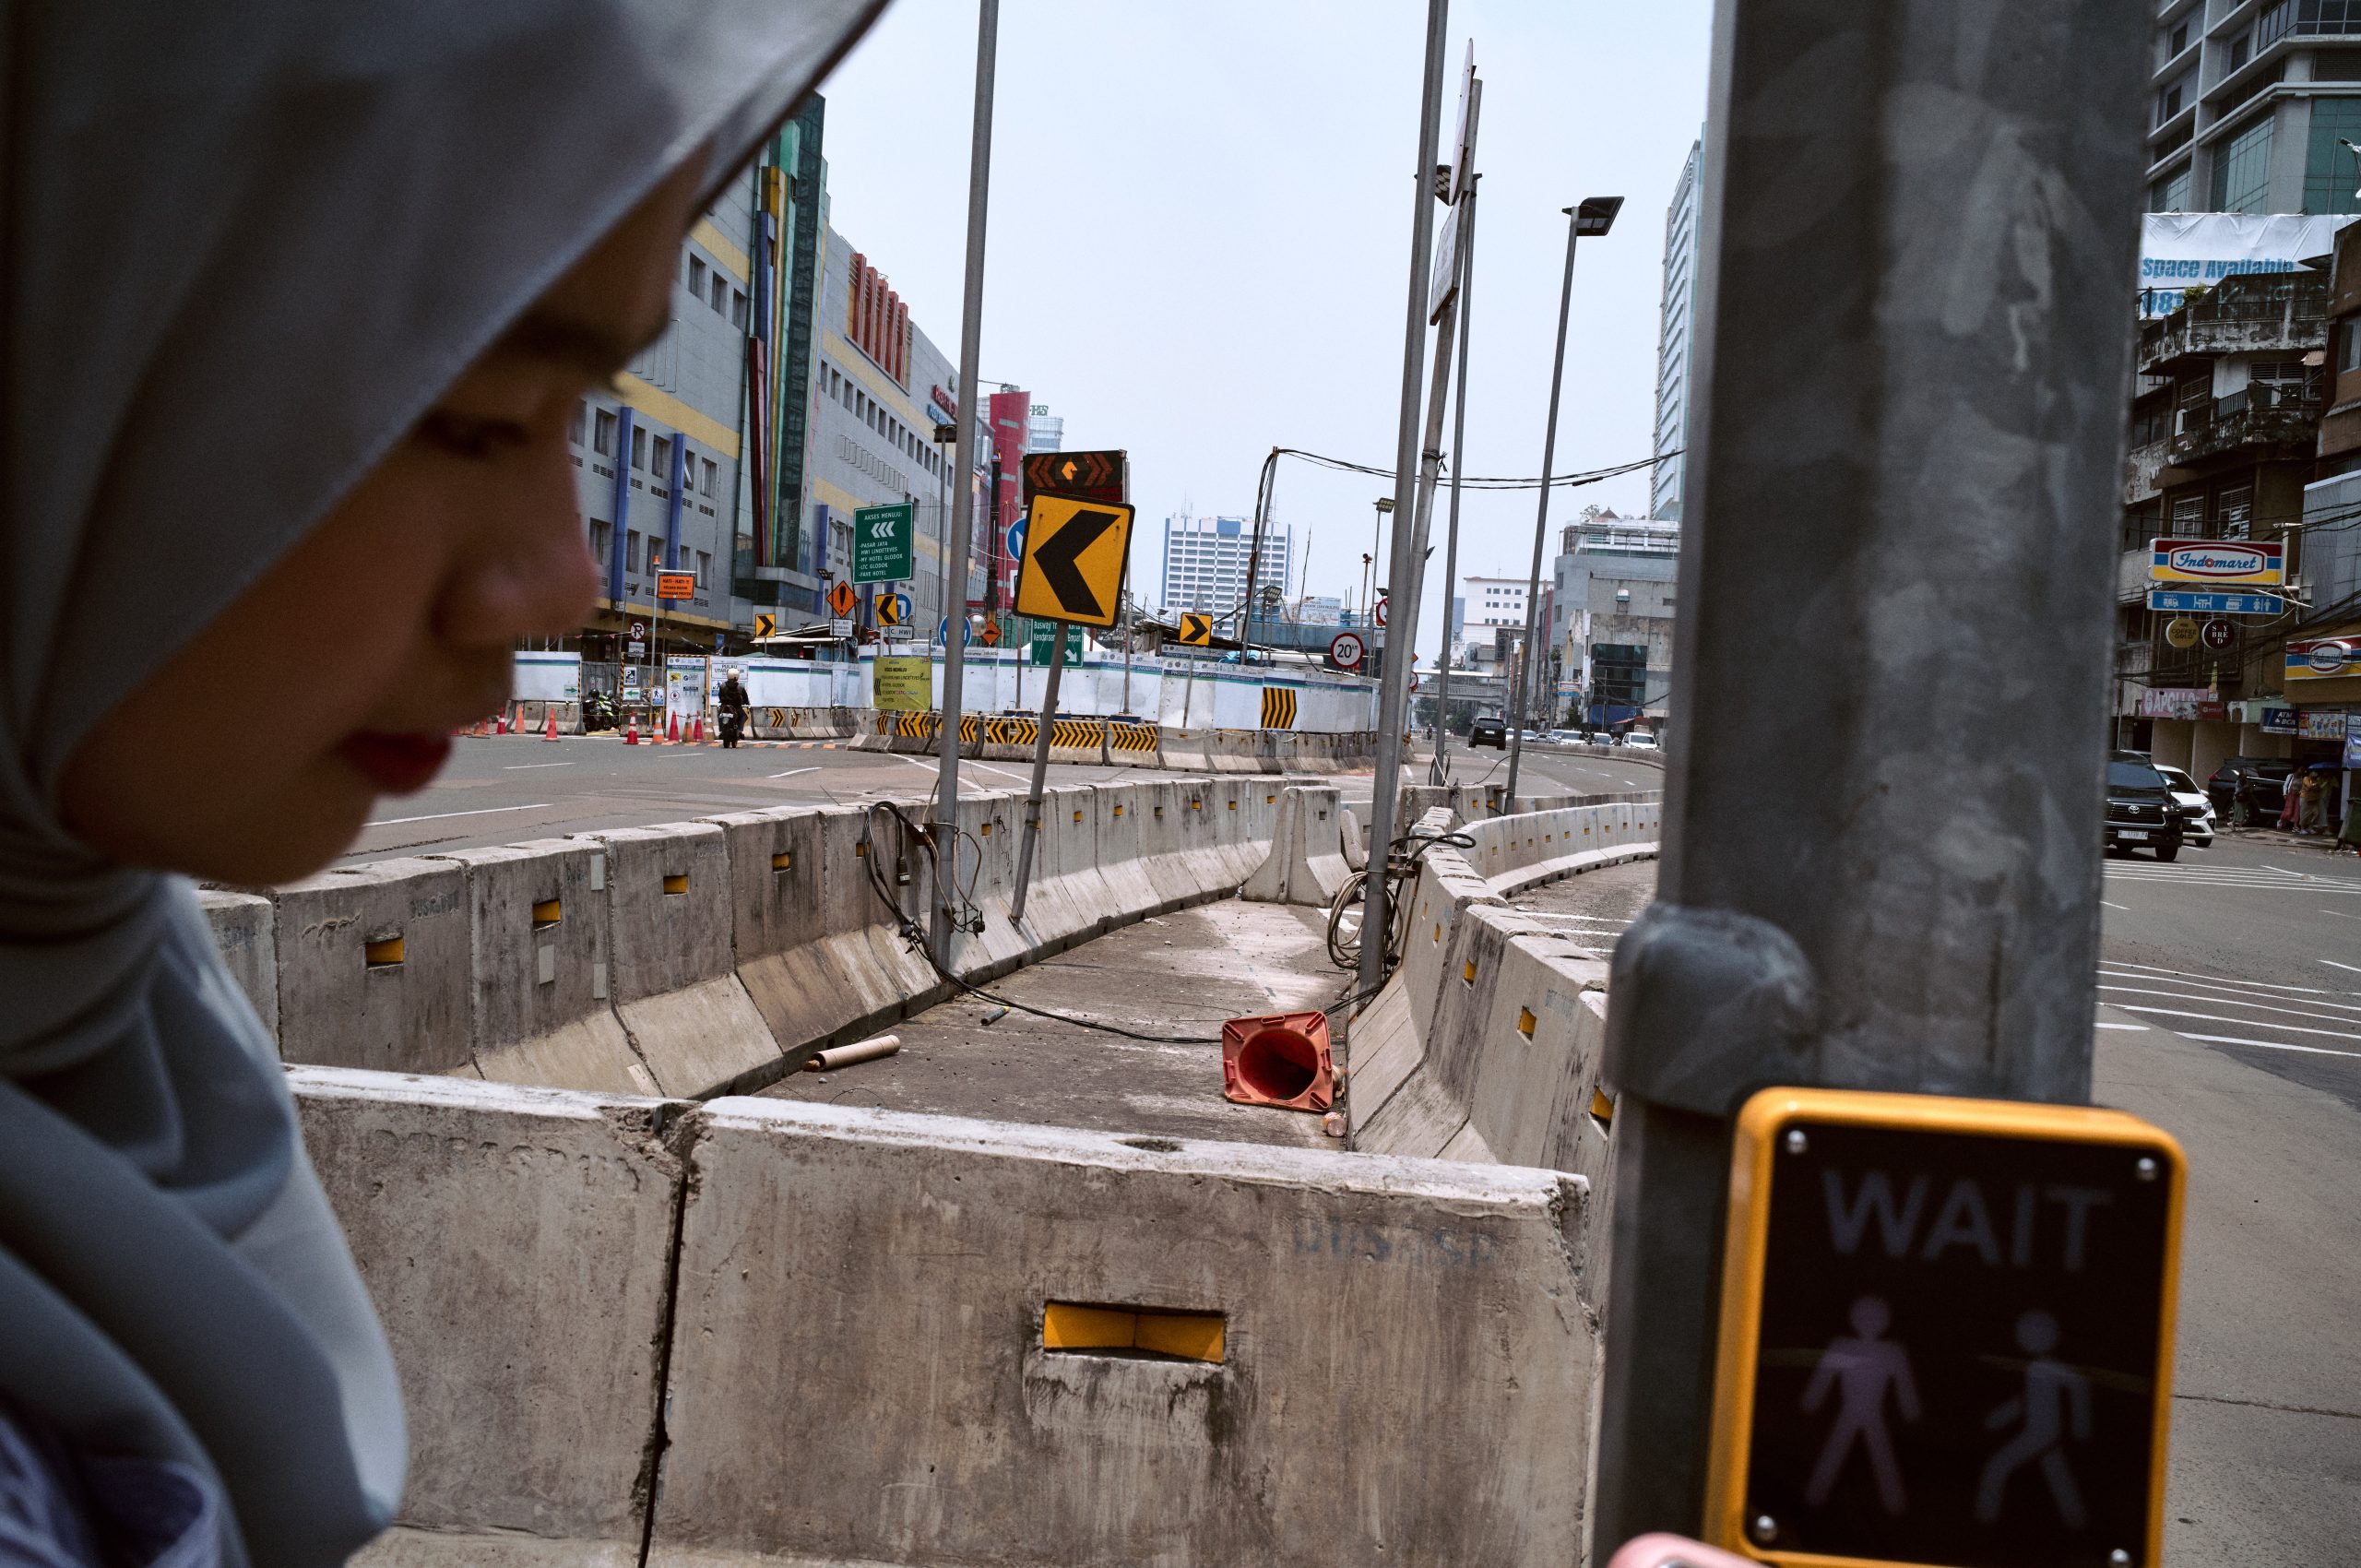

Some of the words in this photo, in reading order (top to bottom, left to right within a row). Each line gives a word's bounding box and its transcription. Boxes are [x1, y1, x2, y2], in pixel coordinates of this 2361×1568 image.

[2142, 257, 2201, 279] Space
[2204, 258, 2294, 279] Available
[2176, 553, 2257, 569] Indomaret
[1034, 621, 1051, 632] Busway
[1068, 633, 1081, 643] Empat
[1820, 1170, 2112, 1274] WAIT
